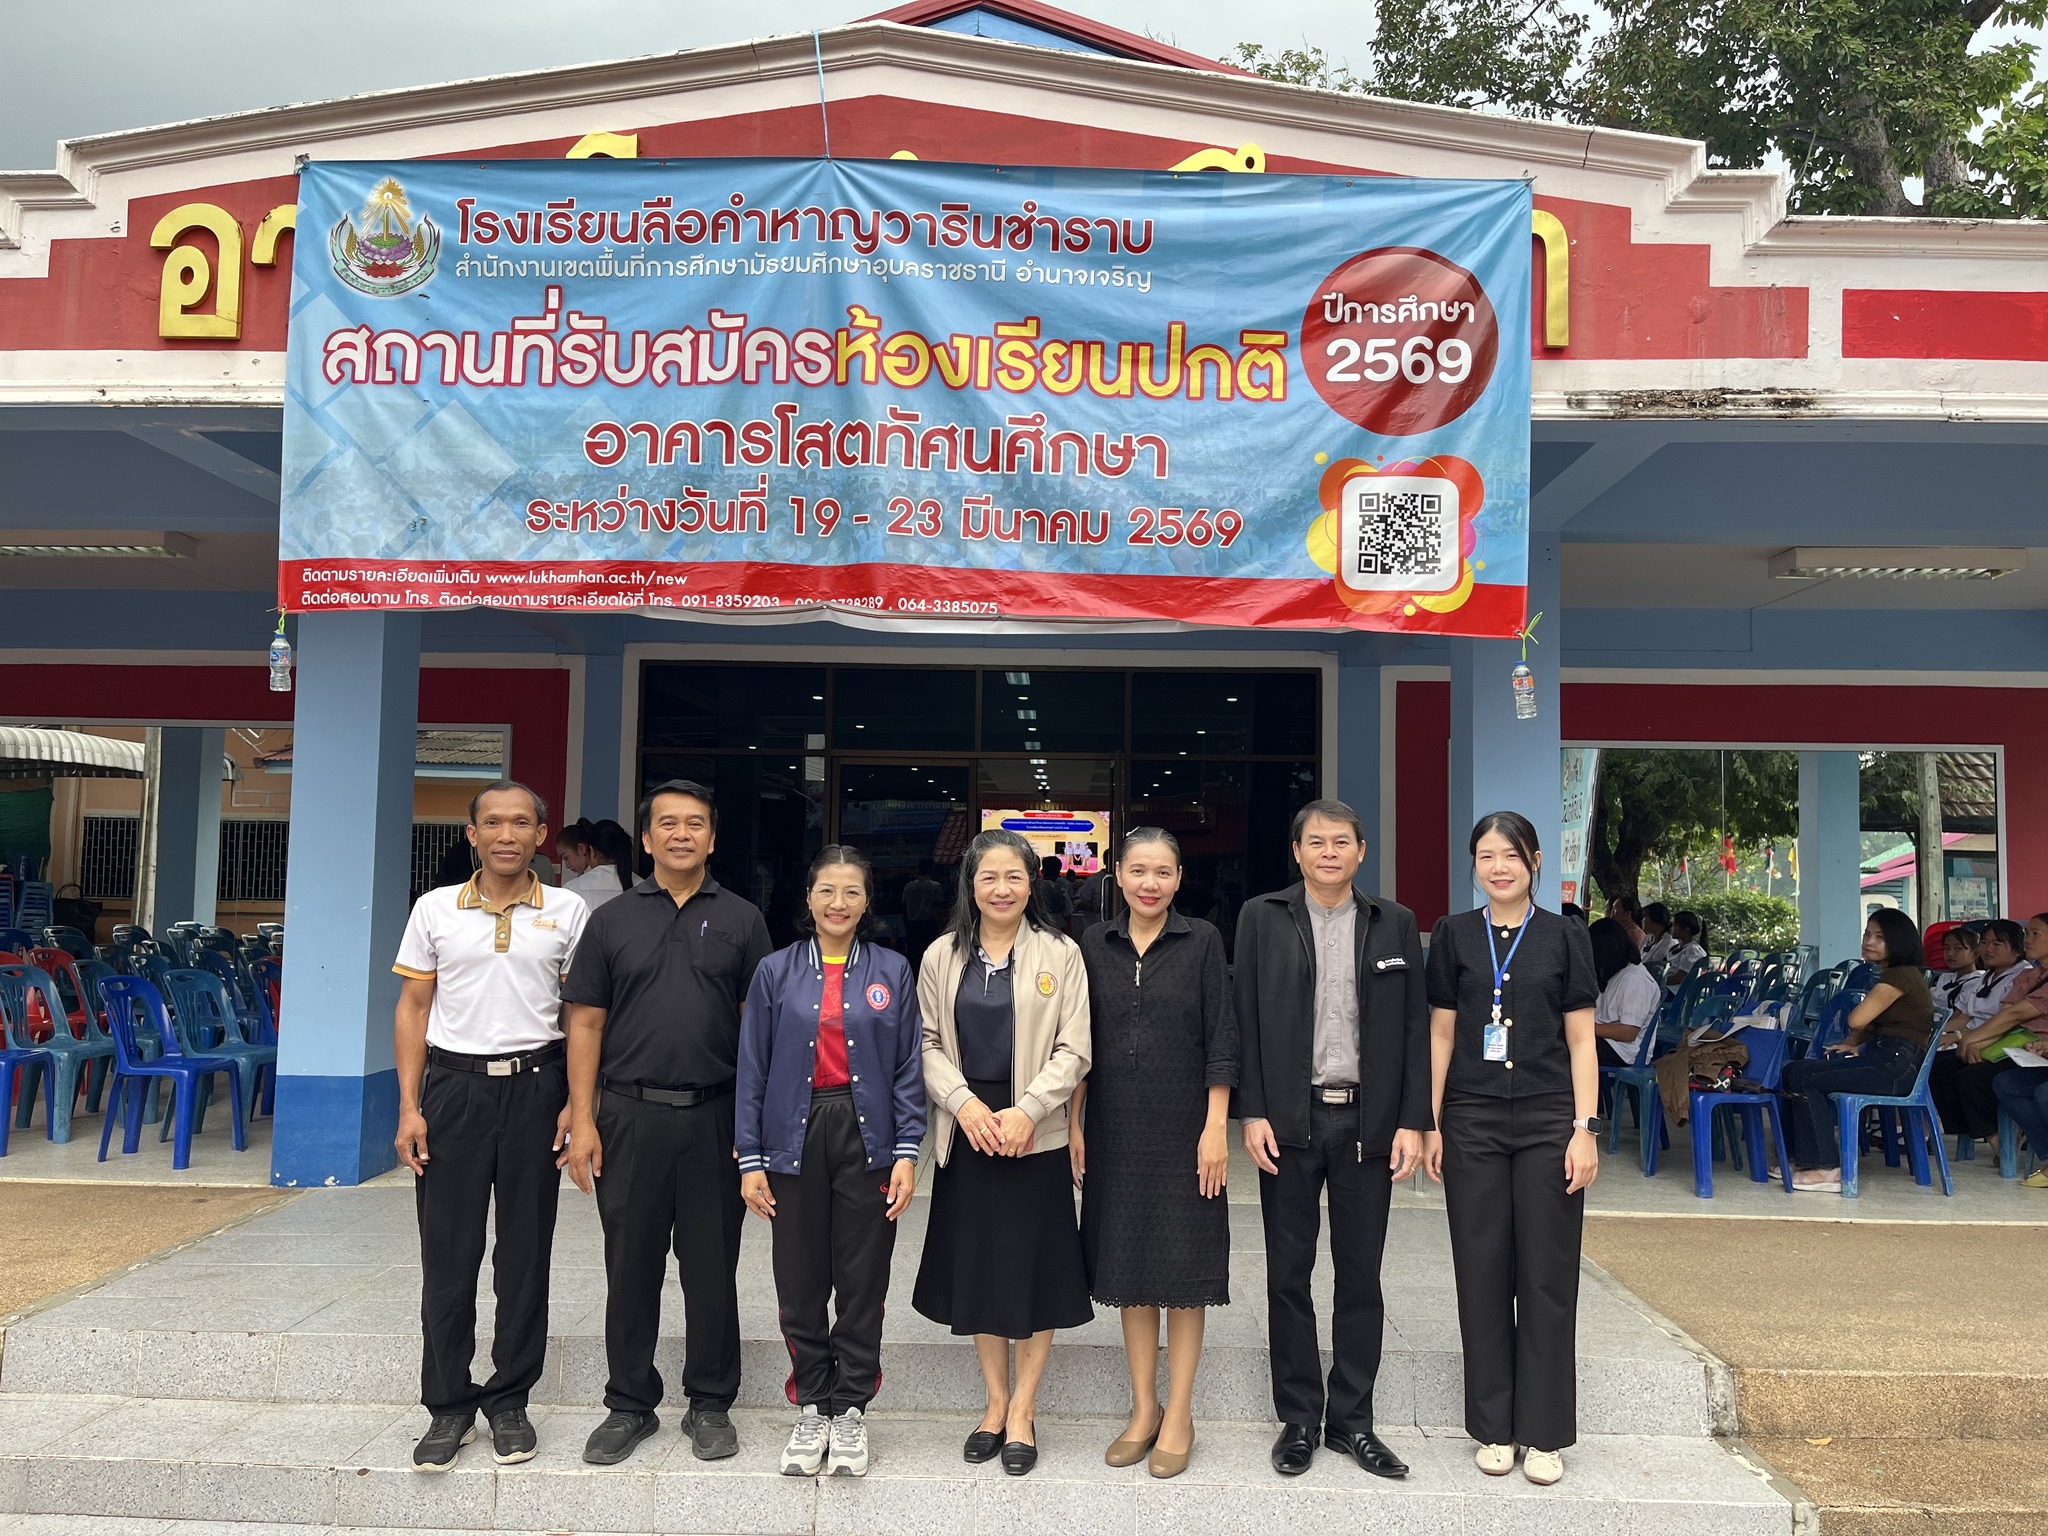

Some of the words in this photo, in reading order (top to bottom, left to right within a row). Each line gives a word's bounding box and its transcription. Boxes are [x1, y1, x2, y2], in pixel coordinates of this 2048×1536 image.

[457, 192, 1154, 255] โรงเรียนลือคำหาญวารินชำราบ
[455, 246, 1007, 285] สำนักงานเขตพื้นที่การศึกษามัธยมศึกษาอุบลราชธานี
[1015, 260, 1152, 293] อำนาจเจริญ
[1322, 292, 1475, 323] ปีการศึกษา
[1326, 336, 1473, 384] 2569
[583, 402, 1169, 479] อาคารโสตทัศนศึกษา
[525, 473, 768, 533] ระหว่างวันที่
[789, 496, 841, 537] 19
[853, 513, 869, 525] -
[886, 496, 943, 537] 23
[960, 494, 1111, 544] มีนาคม
[1127, 507, 1244, 548] 2569
[302, 565, 480, 584] ติดตามรายละเอียดเพิ่มเติม
[485, 570, 688, 587] www.lukhamhan.ac.th/new
[301, 588, 400, 605] ติดต่อสอบถาม
[405, 590, 433, 605] โทร.
[681, 594, 780, 608] 091-8359203
[897, 597, 998, 614] 064-3385075
